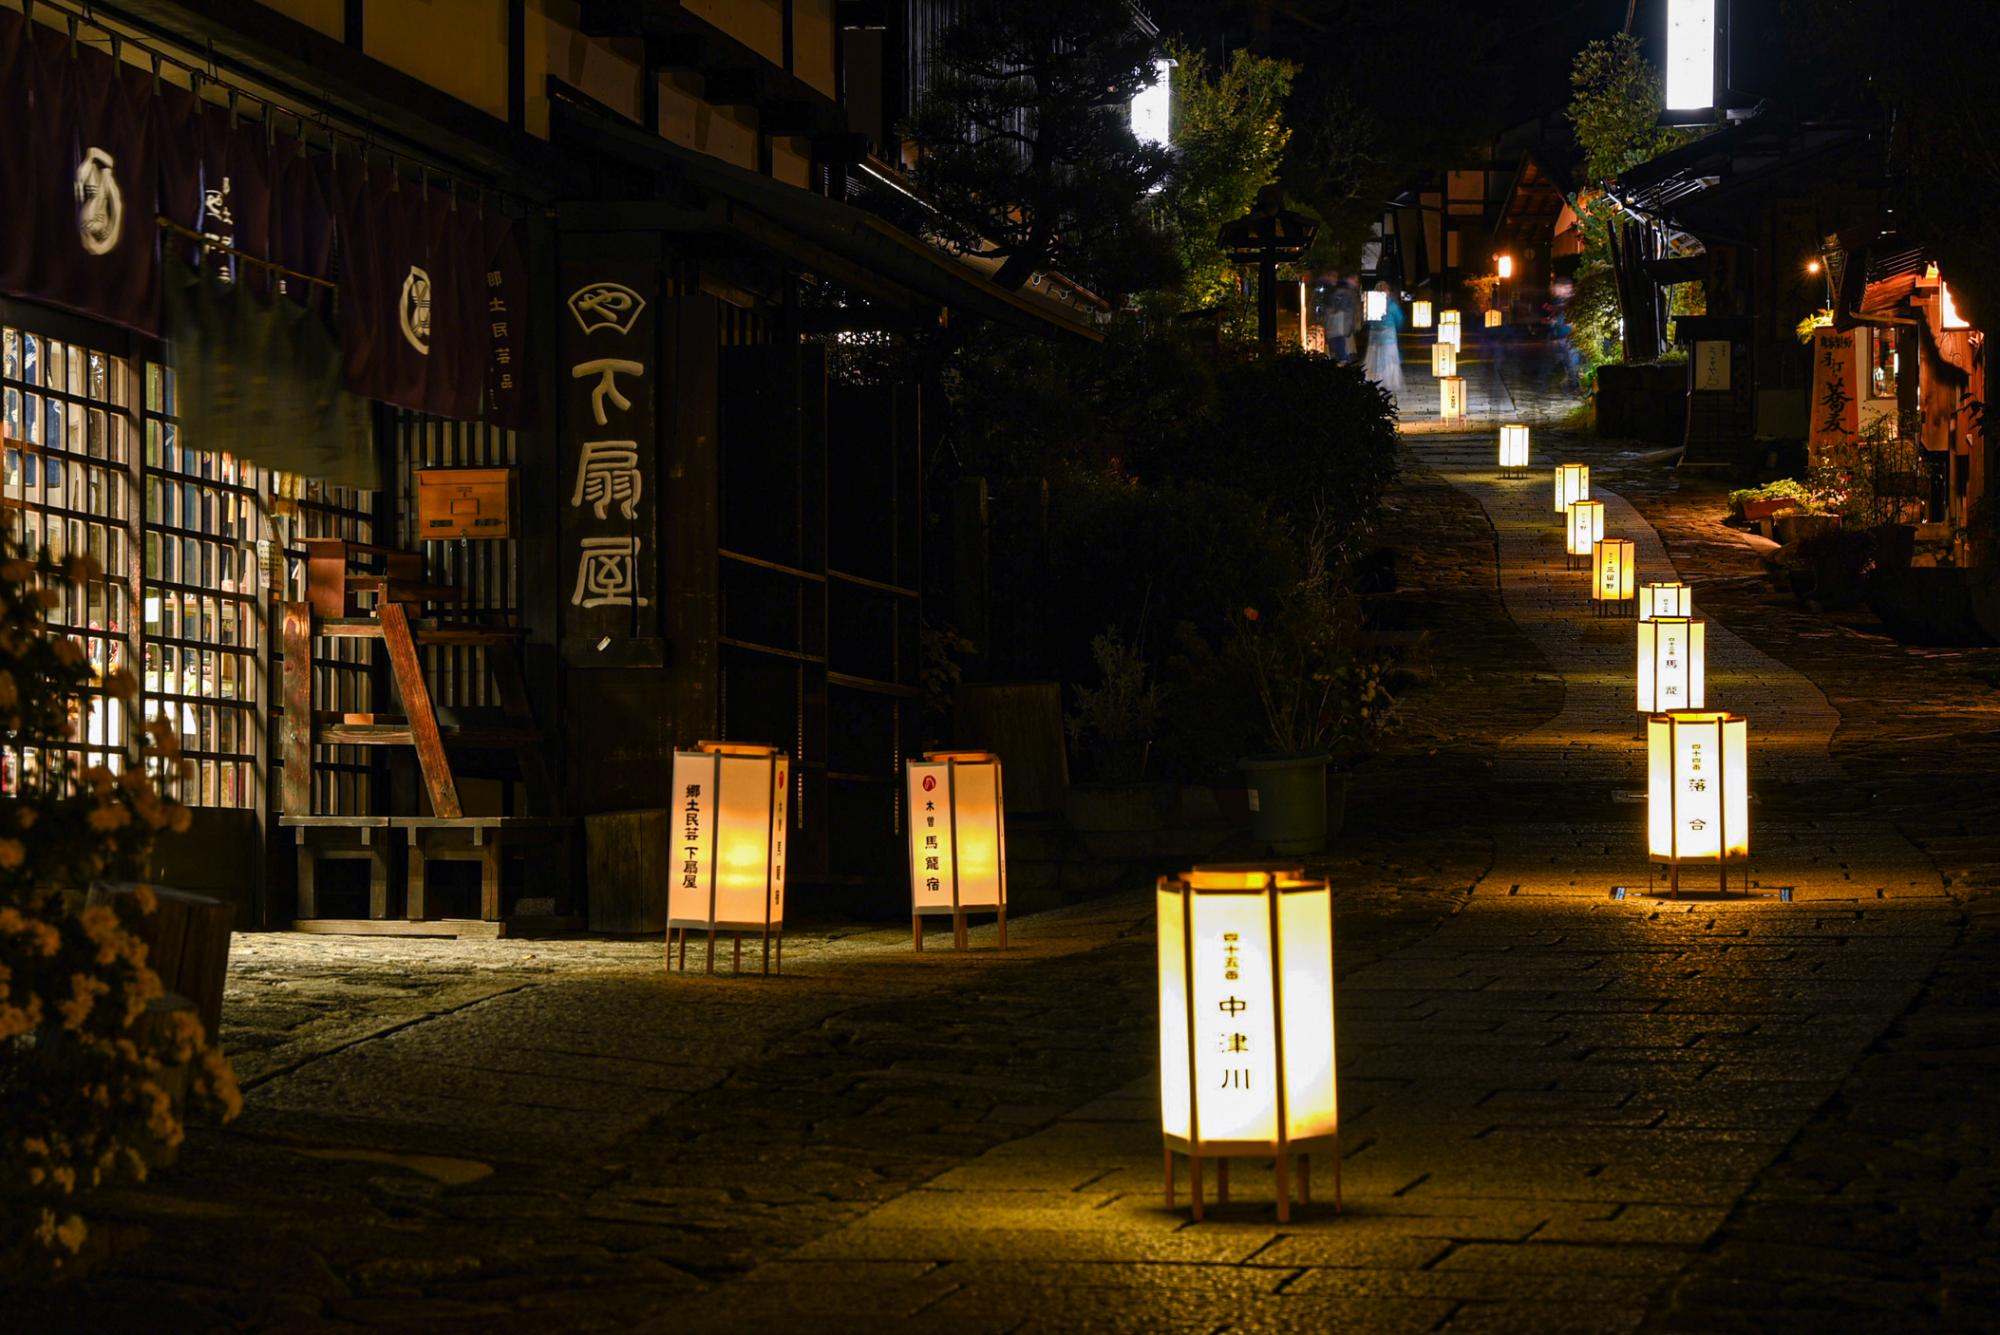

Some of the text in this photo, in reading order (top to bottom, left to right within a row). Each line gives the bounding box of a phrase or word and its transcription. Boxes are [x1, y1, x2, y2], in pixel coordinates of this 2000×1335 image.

[571, 357, 649, 608] 下扇屋
[682, 784, 701, 889] 郷土民芸 下扇屋
[1688, 779, 1707, 831] 落合
[1222, 932, 1240, 980] 四十五番
[1217, 995, 1250, 1089] 中津川
